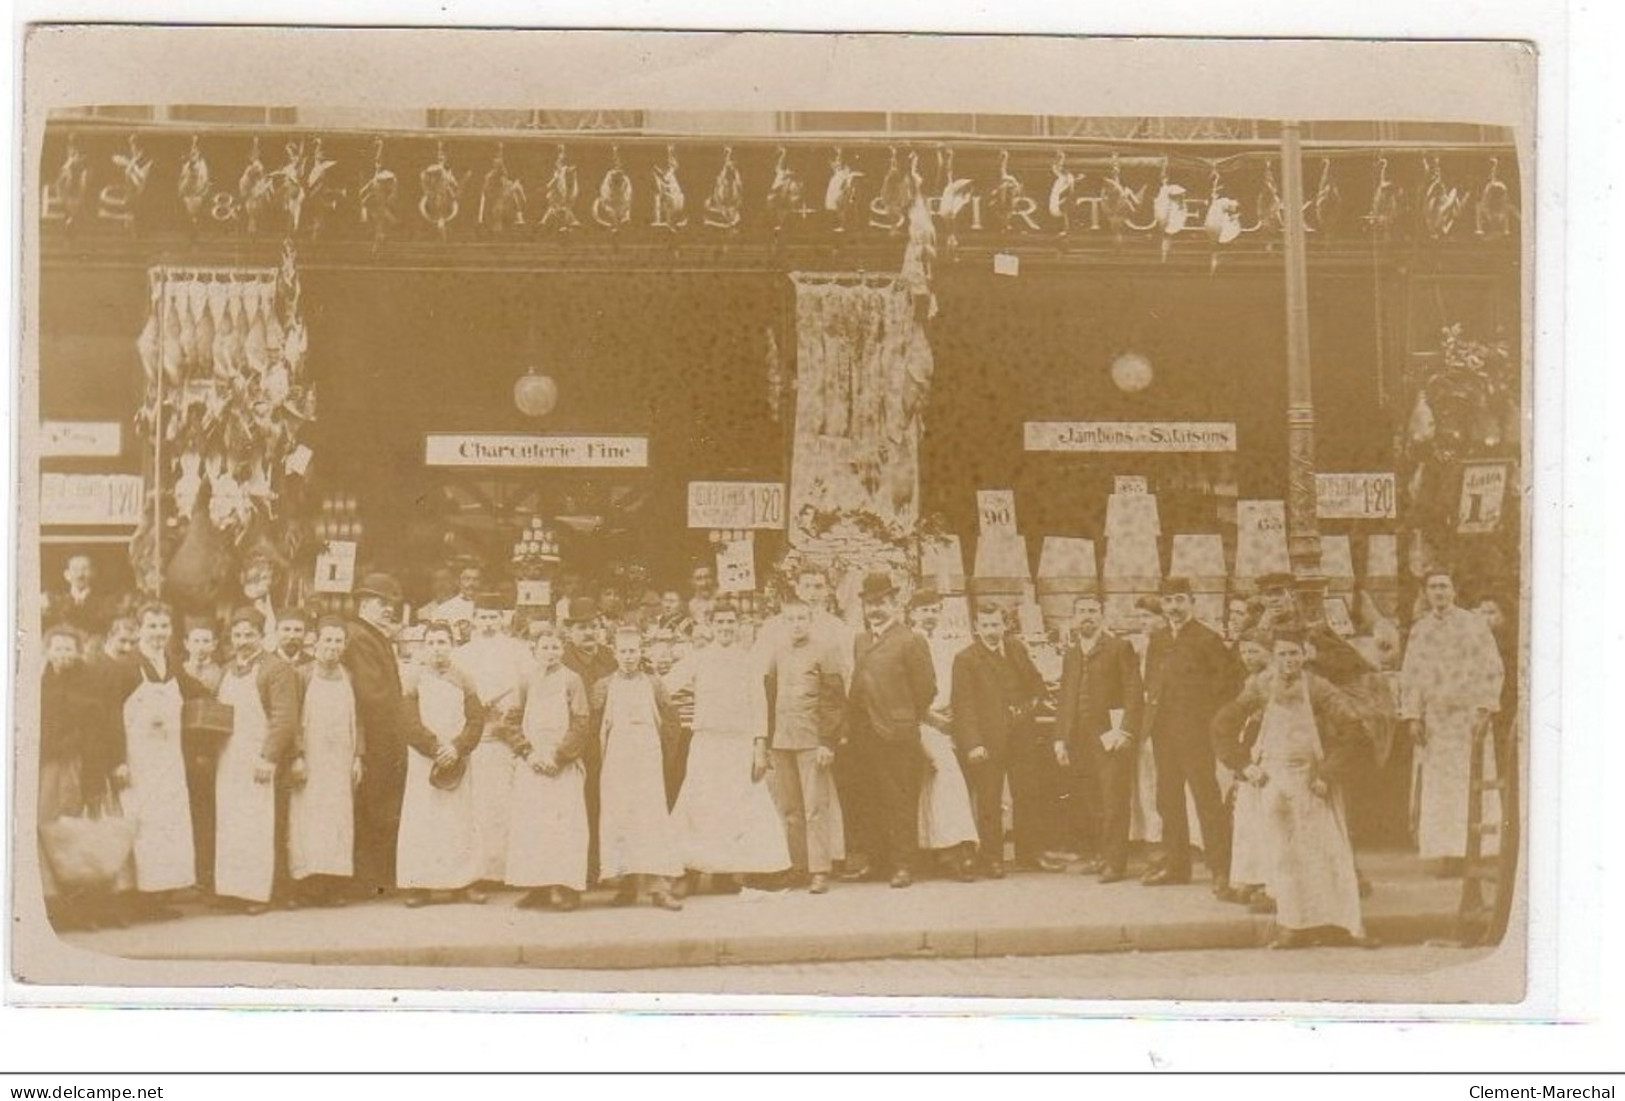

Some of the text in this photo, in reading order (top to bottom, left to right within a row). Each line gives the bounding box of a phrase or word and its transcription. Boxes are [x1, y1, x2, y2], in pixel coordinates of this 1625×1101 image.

[1057, 427, 1134, 444] Jambons
[1149, 427, 1229, 445] Salaisons
[457, 440, 631, 460] Charcuterie Fine
[984, 508, 1010, 527] 90
